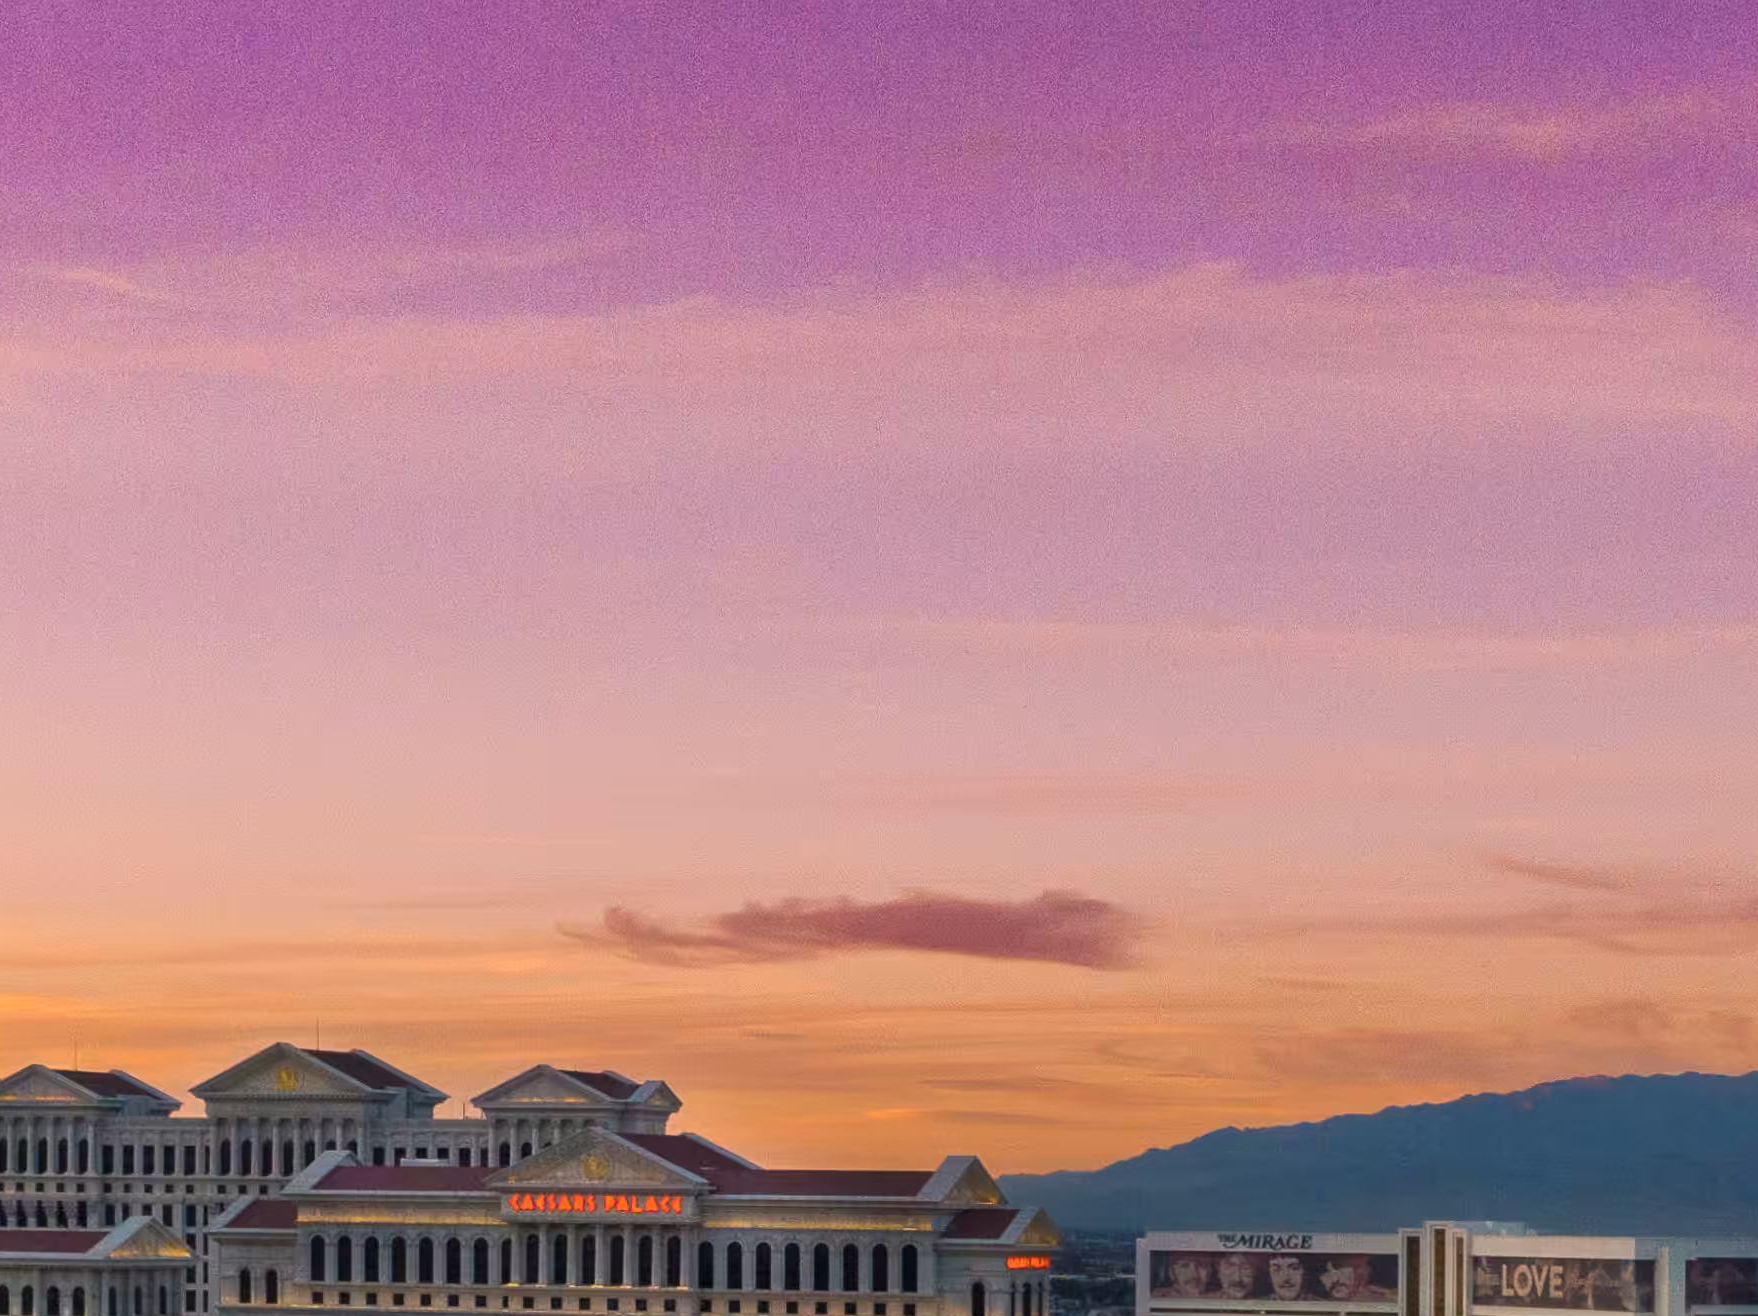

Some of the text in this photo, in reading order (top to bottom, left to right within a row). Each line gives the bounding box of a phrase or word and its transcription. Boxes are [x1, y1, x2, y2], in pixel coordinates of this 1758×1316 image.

[509, 1193, 682, 1215] CAESARS PALACE
[1222, 1234, 1313, 1251] MIRAGE
[1501, 1263, 1564, 1298] LOVE
